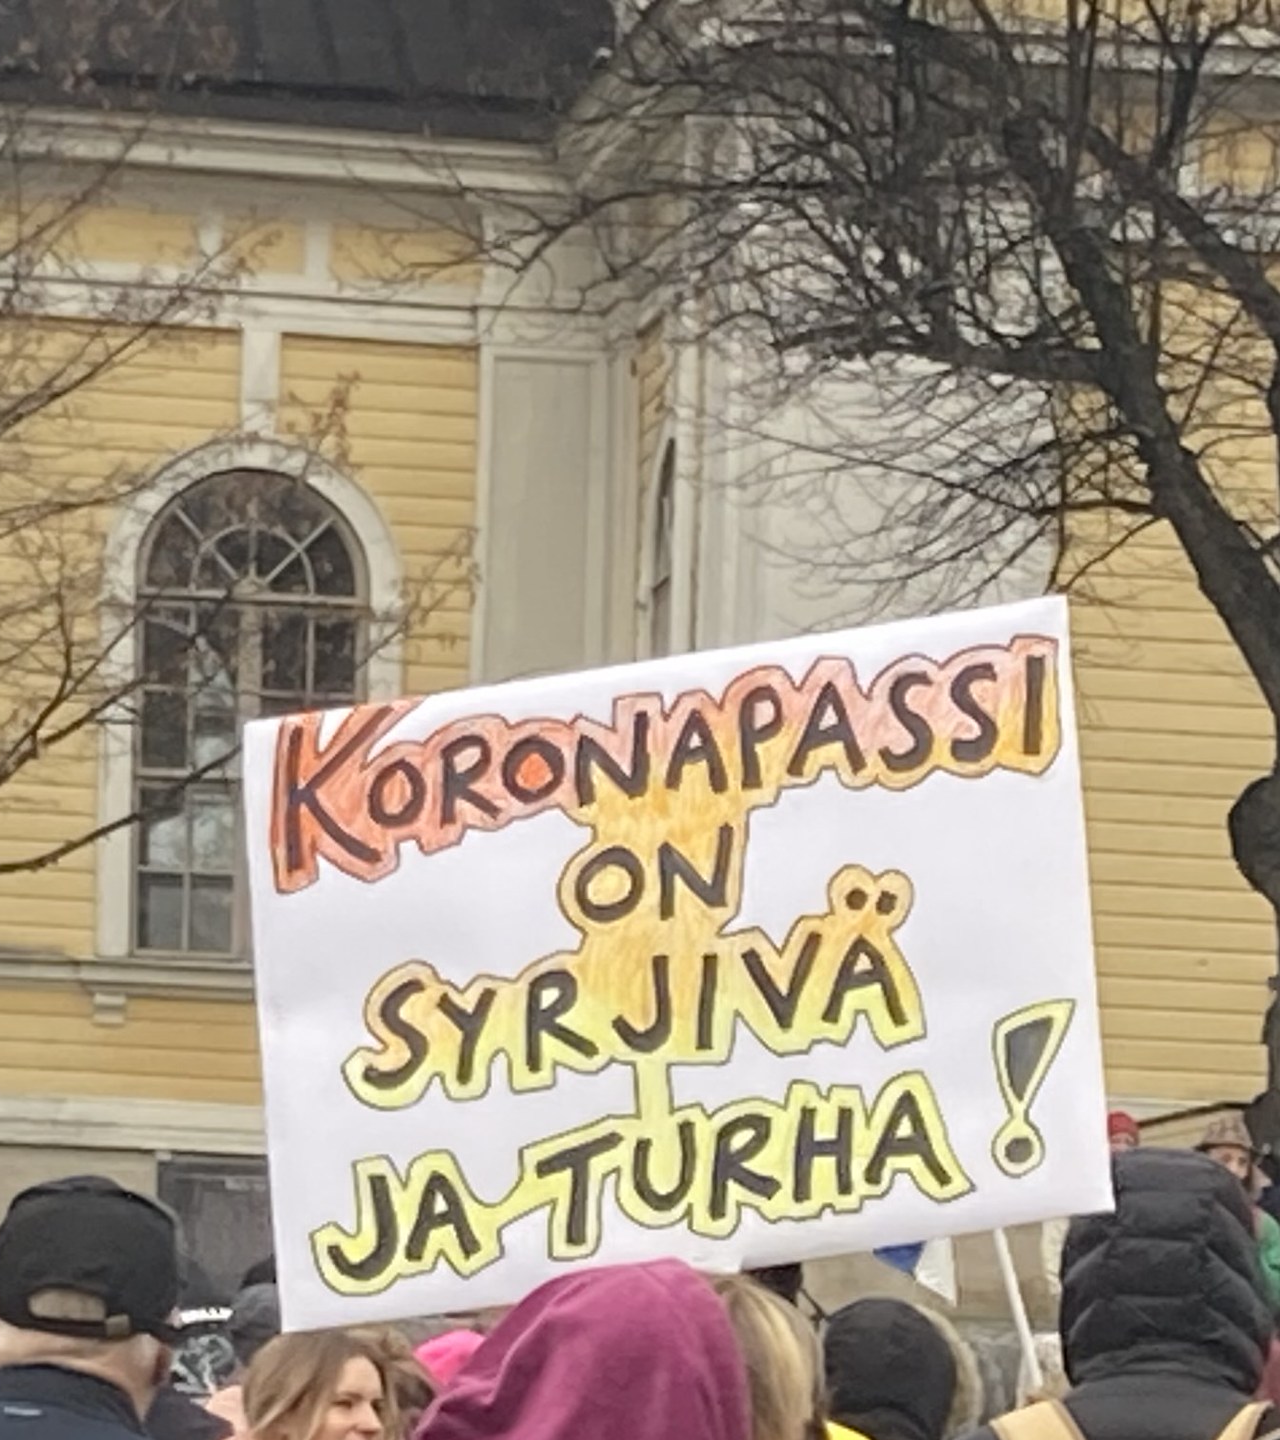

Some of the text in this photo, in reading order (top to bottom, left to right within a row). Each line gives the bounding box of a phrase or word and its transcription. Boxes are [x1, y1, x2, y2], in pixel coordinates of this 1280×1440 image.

[274, 650, 1046, 874] KORONAPASSI
[575, 822, 735, 922] ON
[361, 885, 910, 1088] SYRJIVÄ
[325, 1170, 481, 1281] JA
[535, 1088, 955, 1247] TURHA
